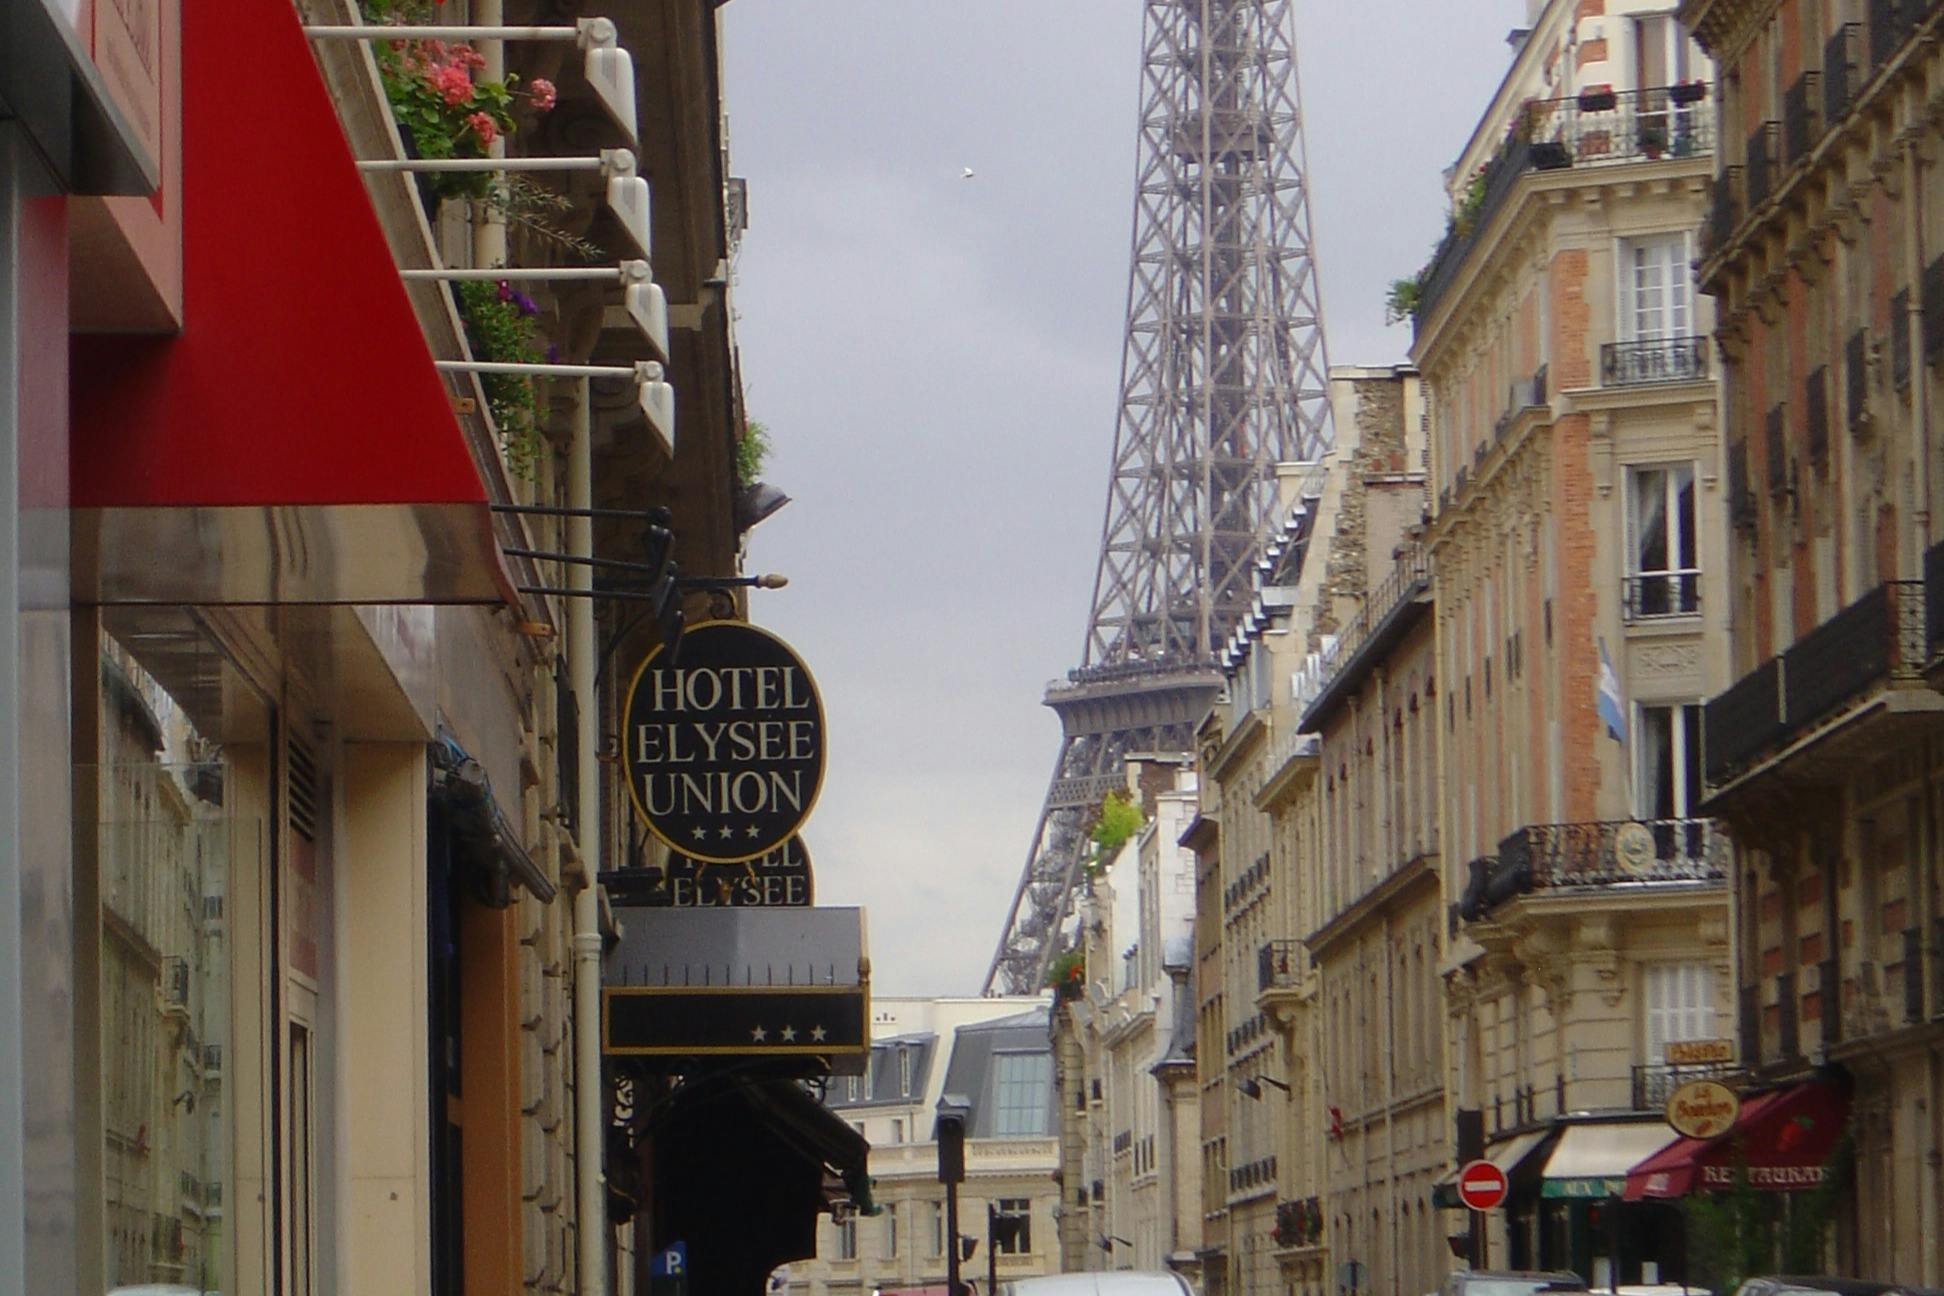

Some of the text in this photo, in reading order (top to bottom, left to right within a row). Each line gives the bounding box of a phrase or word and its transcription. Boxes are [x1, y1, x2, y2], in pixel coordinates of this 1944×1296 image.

[653, 666, 809, 712] HOTEL
[636, 720, 814, 763] ELYSEE
[643, 770, 803, 816] UNION
[666, 1250, 682, 1275] P
